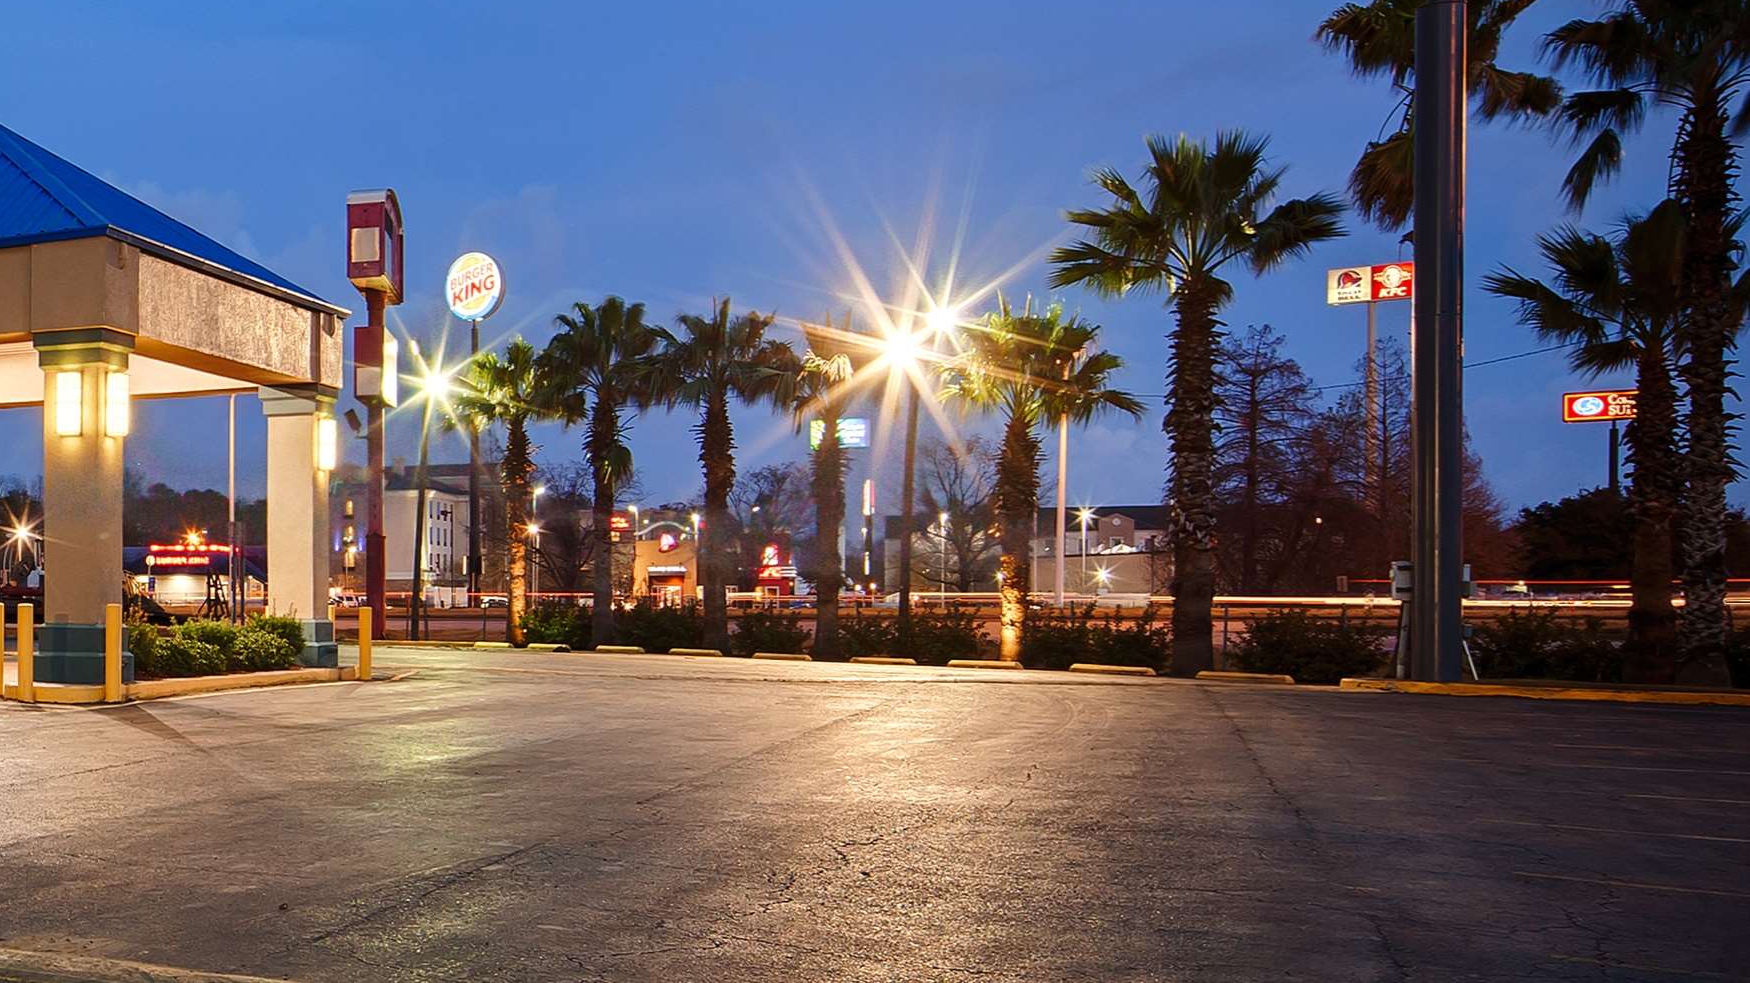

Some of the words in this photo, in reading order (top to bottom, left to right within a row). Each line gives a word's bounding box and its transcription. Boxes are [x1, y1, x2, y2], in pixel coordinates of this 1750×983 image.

[450, 262, 494, 291] BURGER
[452, 274, 495, 307] KING
[1379, 286, 1408, 298] KFC
